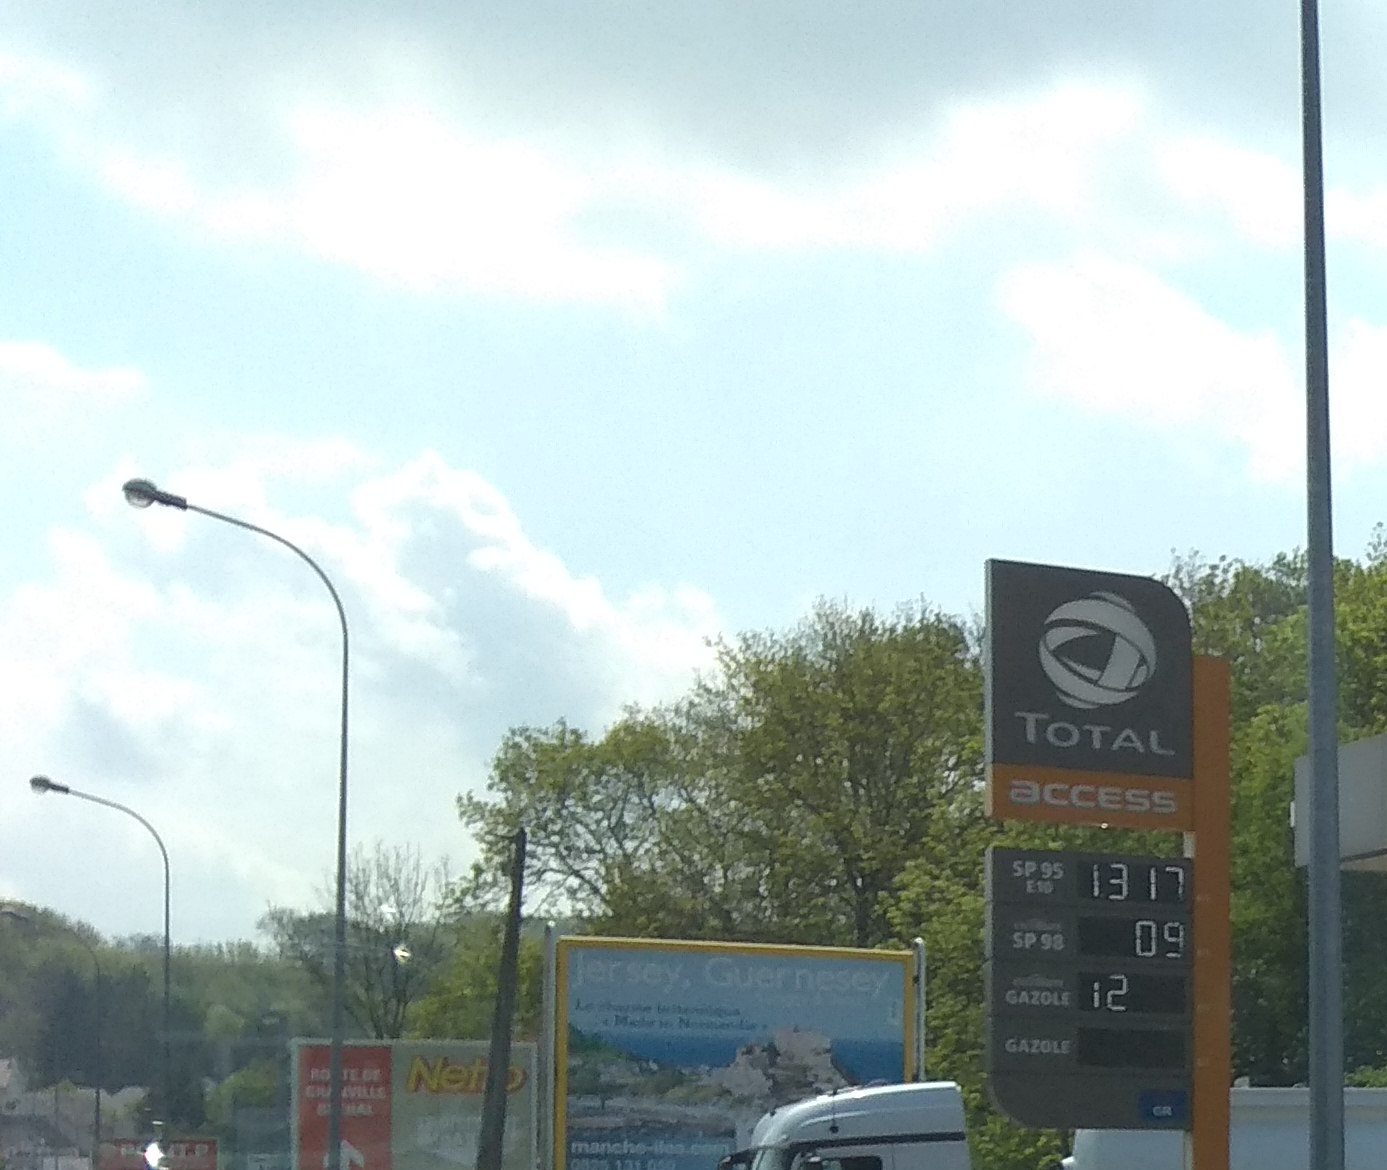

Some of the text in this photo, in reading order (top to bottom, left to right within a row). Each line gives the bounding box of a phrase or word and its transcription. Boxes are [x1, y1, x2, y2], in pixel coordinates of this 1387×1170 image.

[1014, 711, 1176, 757] TOTAL
[1009, 779, 1179, 816] access
[705, 957, 891, 1000] Guernesey
[1005, 989, 1073, 1008] GAZOLE
[1004, 1038, 1073, 1055] GAZOLE
[311, 1068, 360, 1081] ROTE
[406, 1055, 529, 1096] Neto
